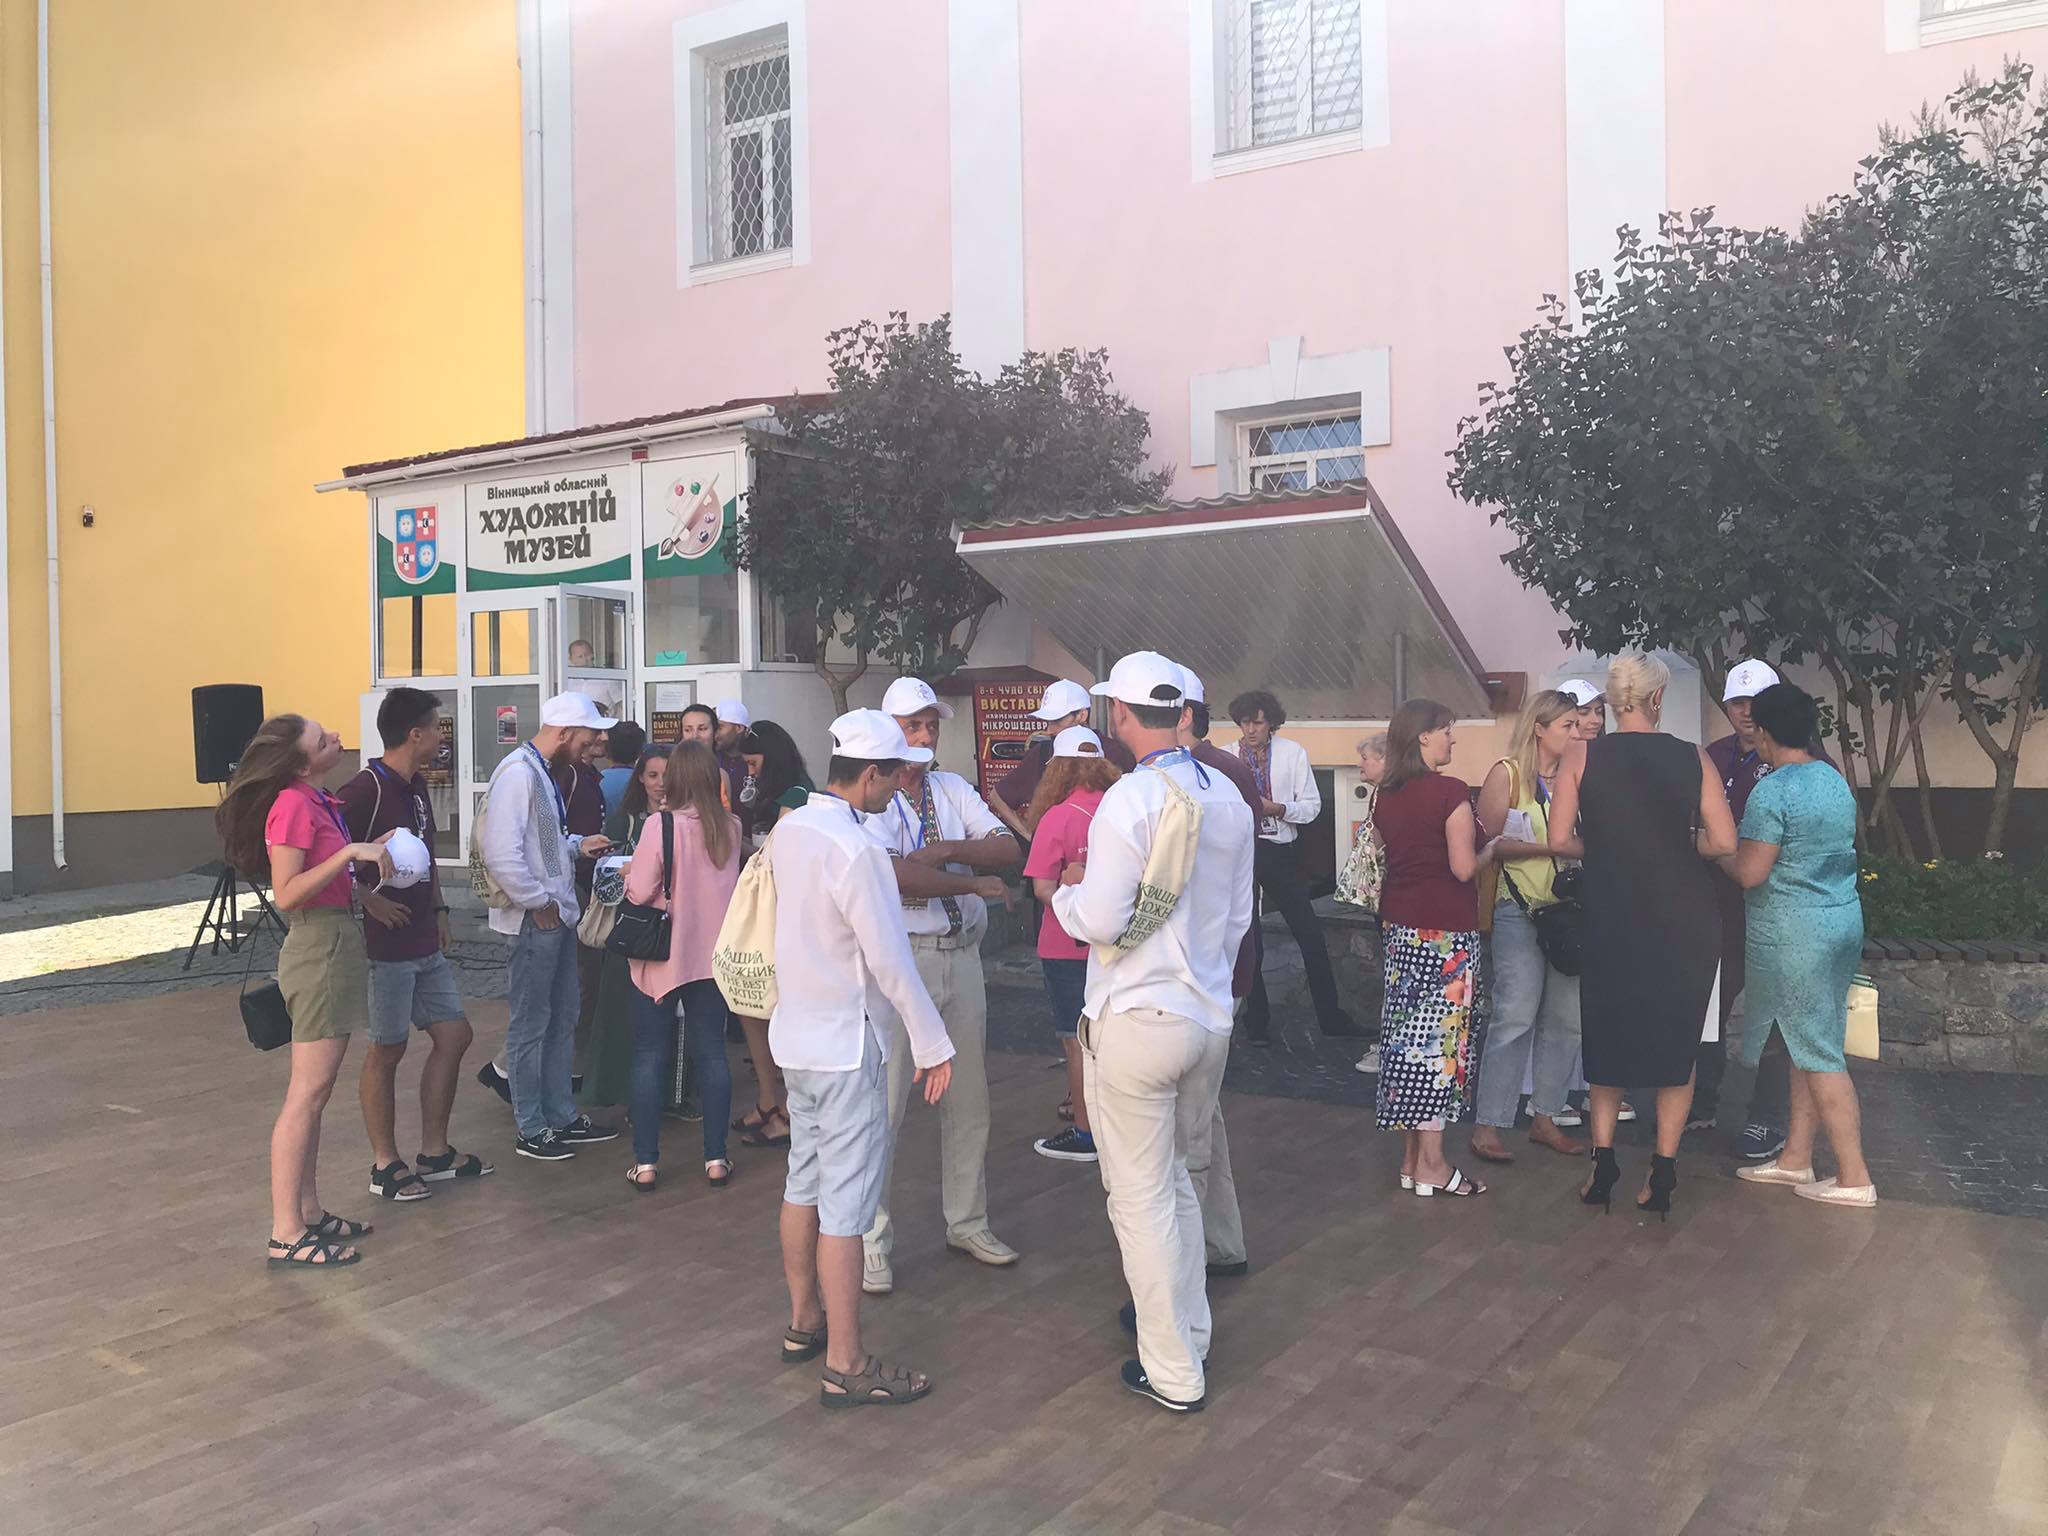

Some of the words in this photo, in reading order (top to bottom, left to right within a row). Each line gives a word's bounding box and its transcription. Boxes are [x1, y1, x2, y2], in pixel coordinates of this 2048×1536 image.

[487, 480, 550, 500] Вінницький
[554, 474, 608, 492] обласний
[480, 489, 616, 538] ХУДОЖНІЙ
[504, 525, 591, 564] МУЗЕЙ
[999, 686, 1023, 695] ЧУДО
[1027, 685, 1047, 694] СВІТ
[981, 698, 1042, 710] ВИСТАВК
[982, 721, 1048, 731] МІКРОШЕДЕВР
[1137, 900, 1173, 919] ДОЖН
[729, 985, 765, 1001] ARTIST
[743, 980, 767, 990] BEST
